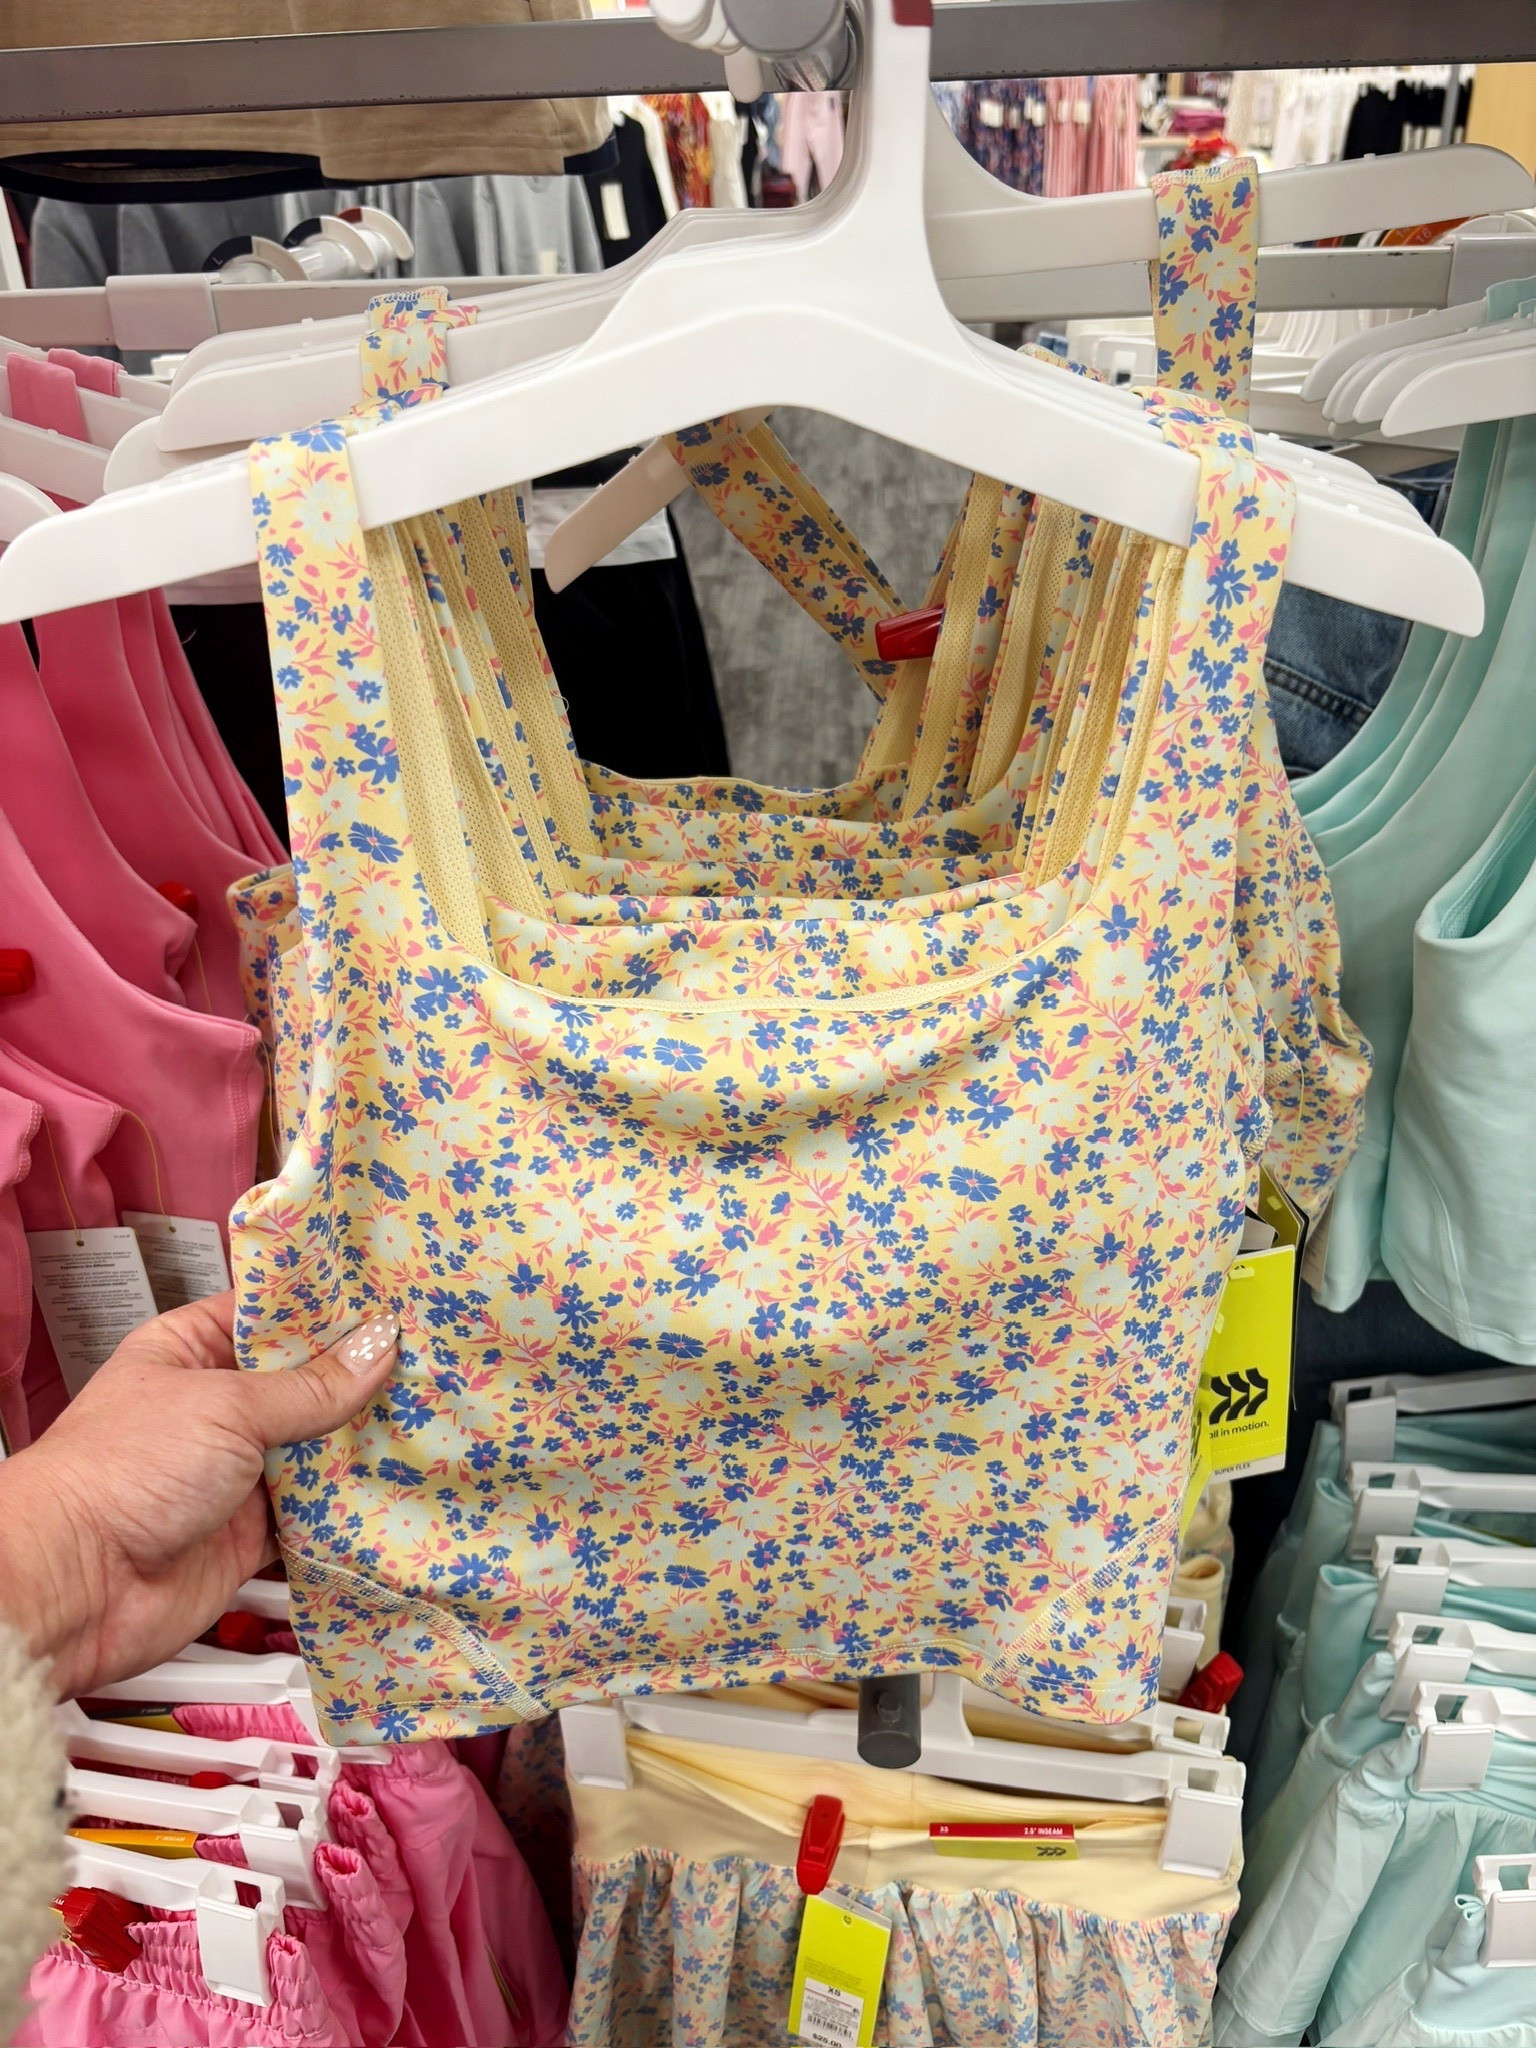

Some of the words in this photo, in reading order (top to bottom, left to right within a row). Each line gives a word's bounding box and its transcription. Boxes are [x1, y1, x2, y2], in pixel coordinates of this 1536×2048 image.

[1416, 228, 1432, 242] 16
[212, 256, 224, 266] L
[1220, 1428, 1230, 1437] in
[1232, 1420, 1269, 1434] motion.
[1214, 1466, 1235, 1476] SUPER
[1236, 1462, 1251, 1471] FLEX
[828, 1986, 842, 1997] XS
[812, 2033, 843, 2048] $25.00
